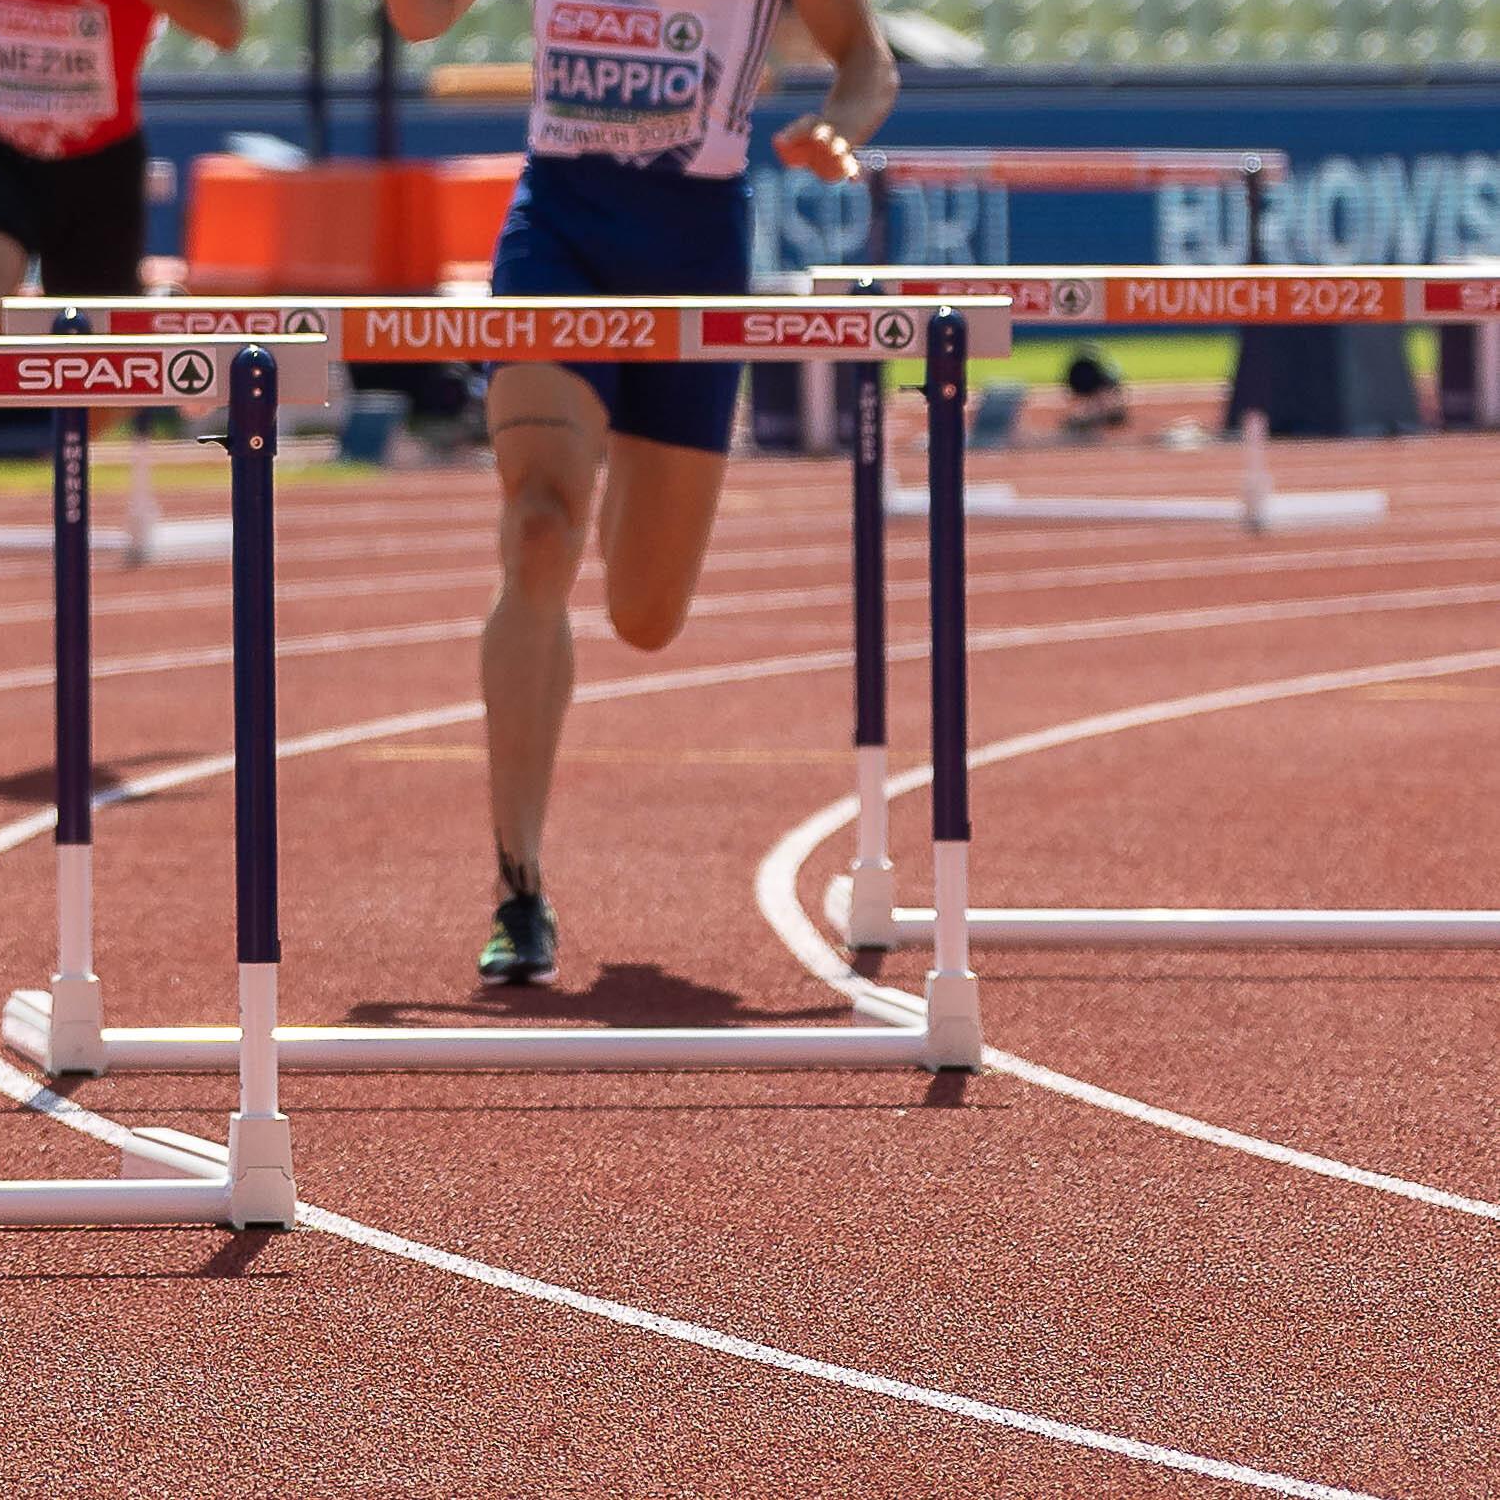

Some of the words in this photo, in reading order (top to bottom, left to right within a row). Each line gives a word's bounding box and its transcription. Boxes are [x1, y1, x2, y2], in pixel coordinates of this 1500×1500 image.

[553, 7, 659, 43] SPAR
[546, 54, 700, 106] HAPPIO
[1123, 280, 1278, 315] MUNICH
[1290, 280, 1385, 315] 2022
[152, 313, 281, 334] SPAR
[365, 309, 537, 348] MUNICH
[550, 309, 657, 348] 2022
[742, 314, 868, 346] SPAR
[17, 357, 160, 391] SPAR
